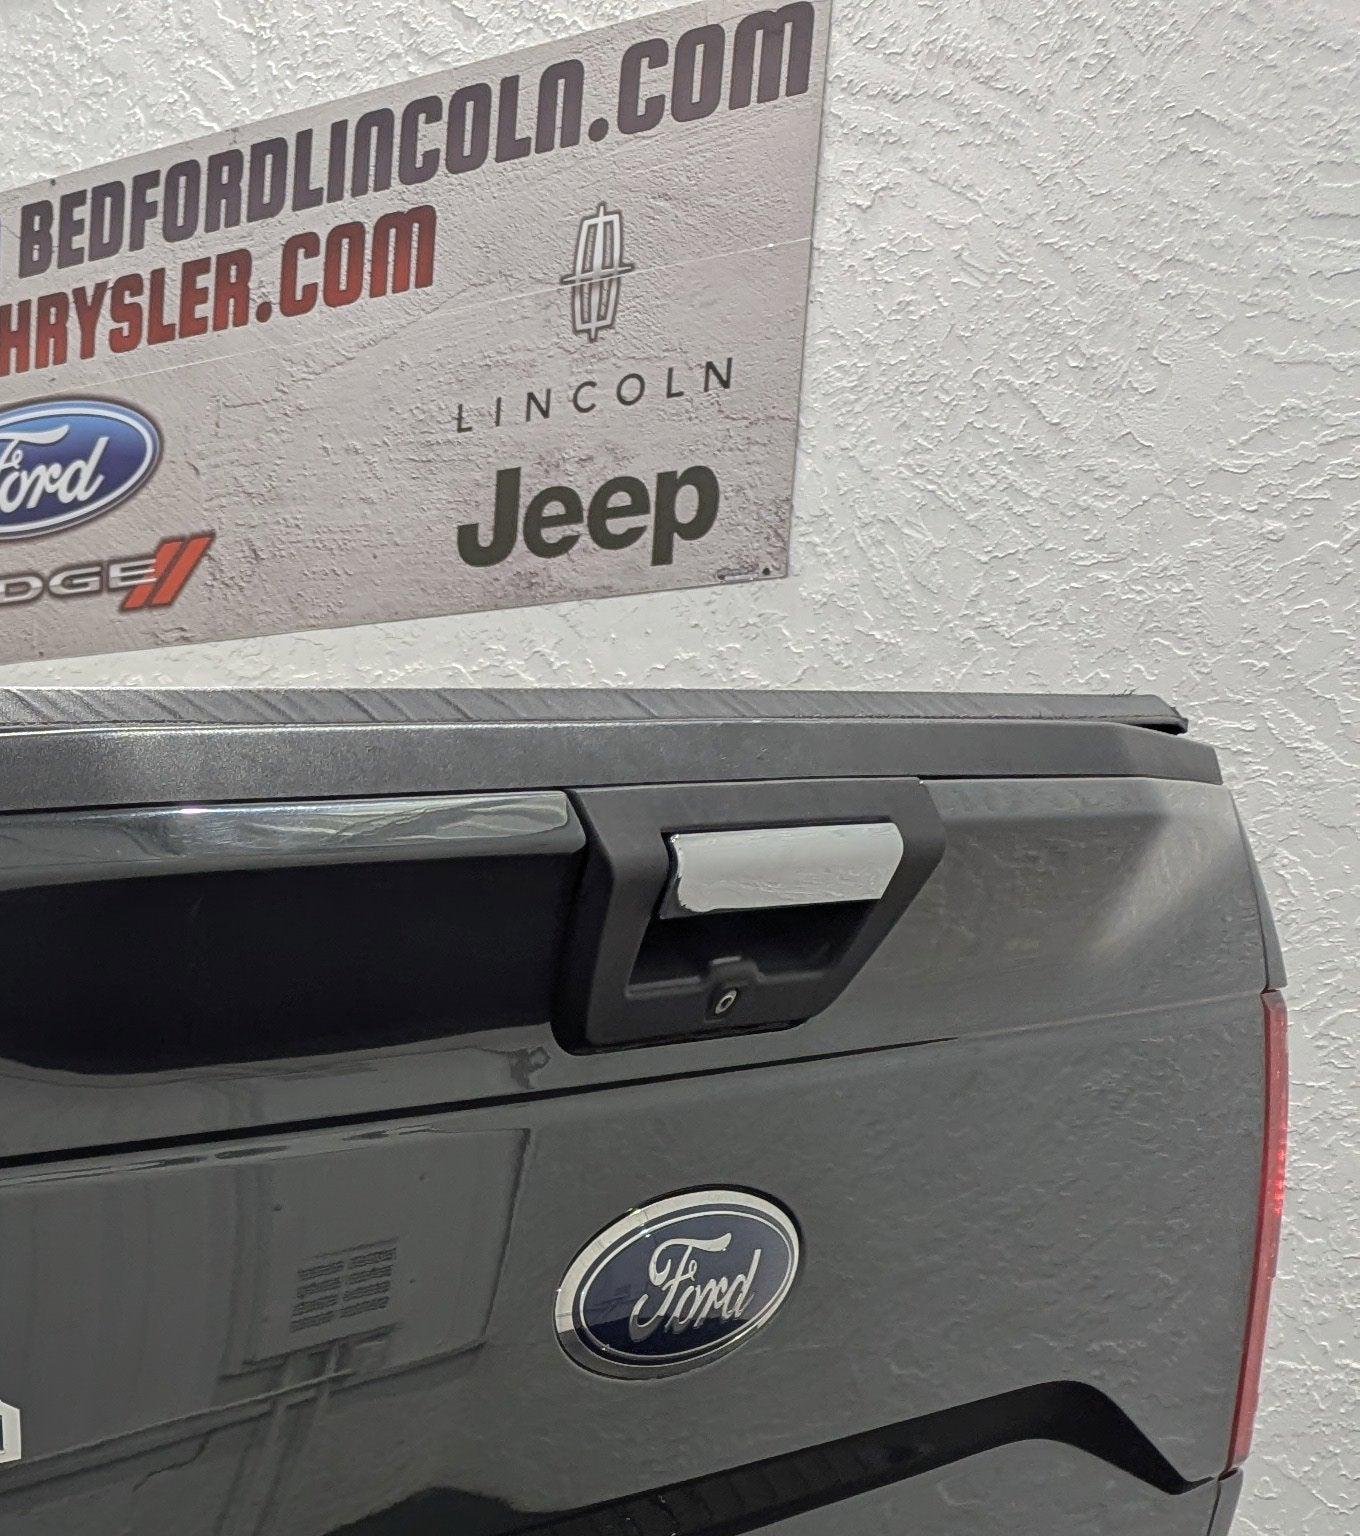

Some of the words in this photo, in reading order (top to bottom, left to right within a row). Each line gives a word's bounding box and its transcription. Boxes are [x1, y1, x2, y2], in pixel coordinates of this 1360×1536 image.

[18, 1, 815, 279] BEDFORDLINCOLN.COM
[457, 357, 733, 433] LINCOLN
[457, 465, 720, 567] Jeep
[630, 1232, 761, 1342] Ford
